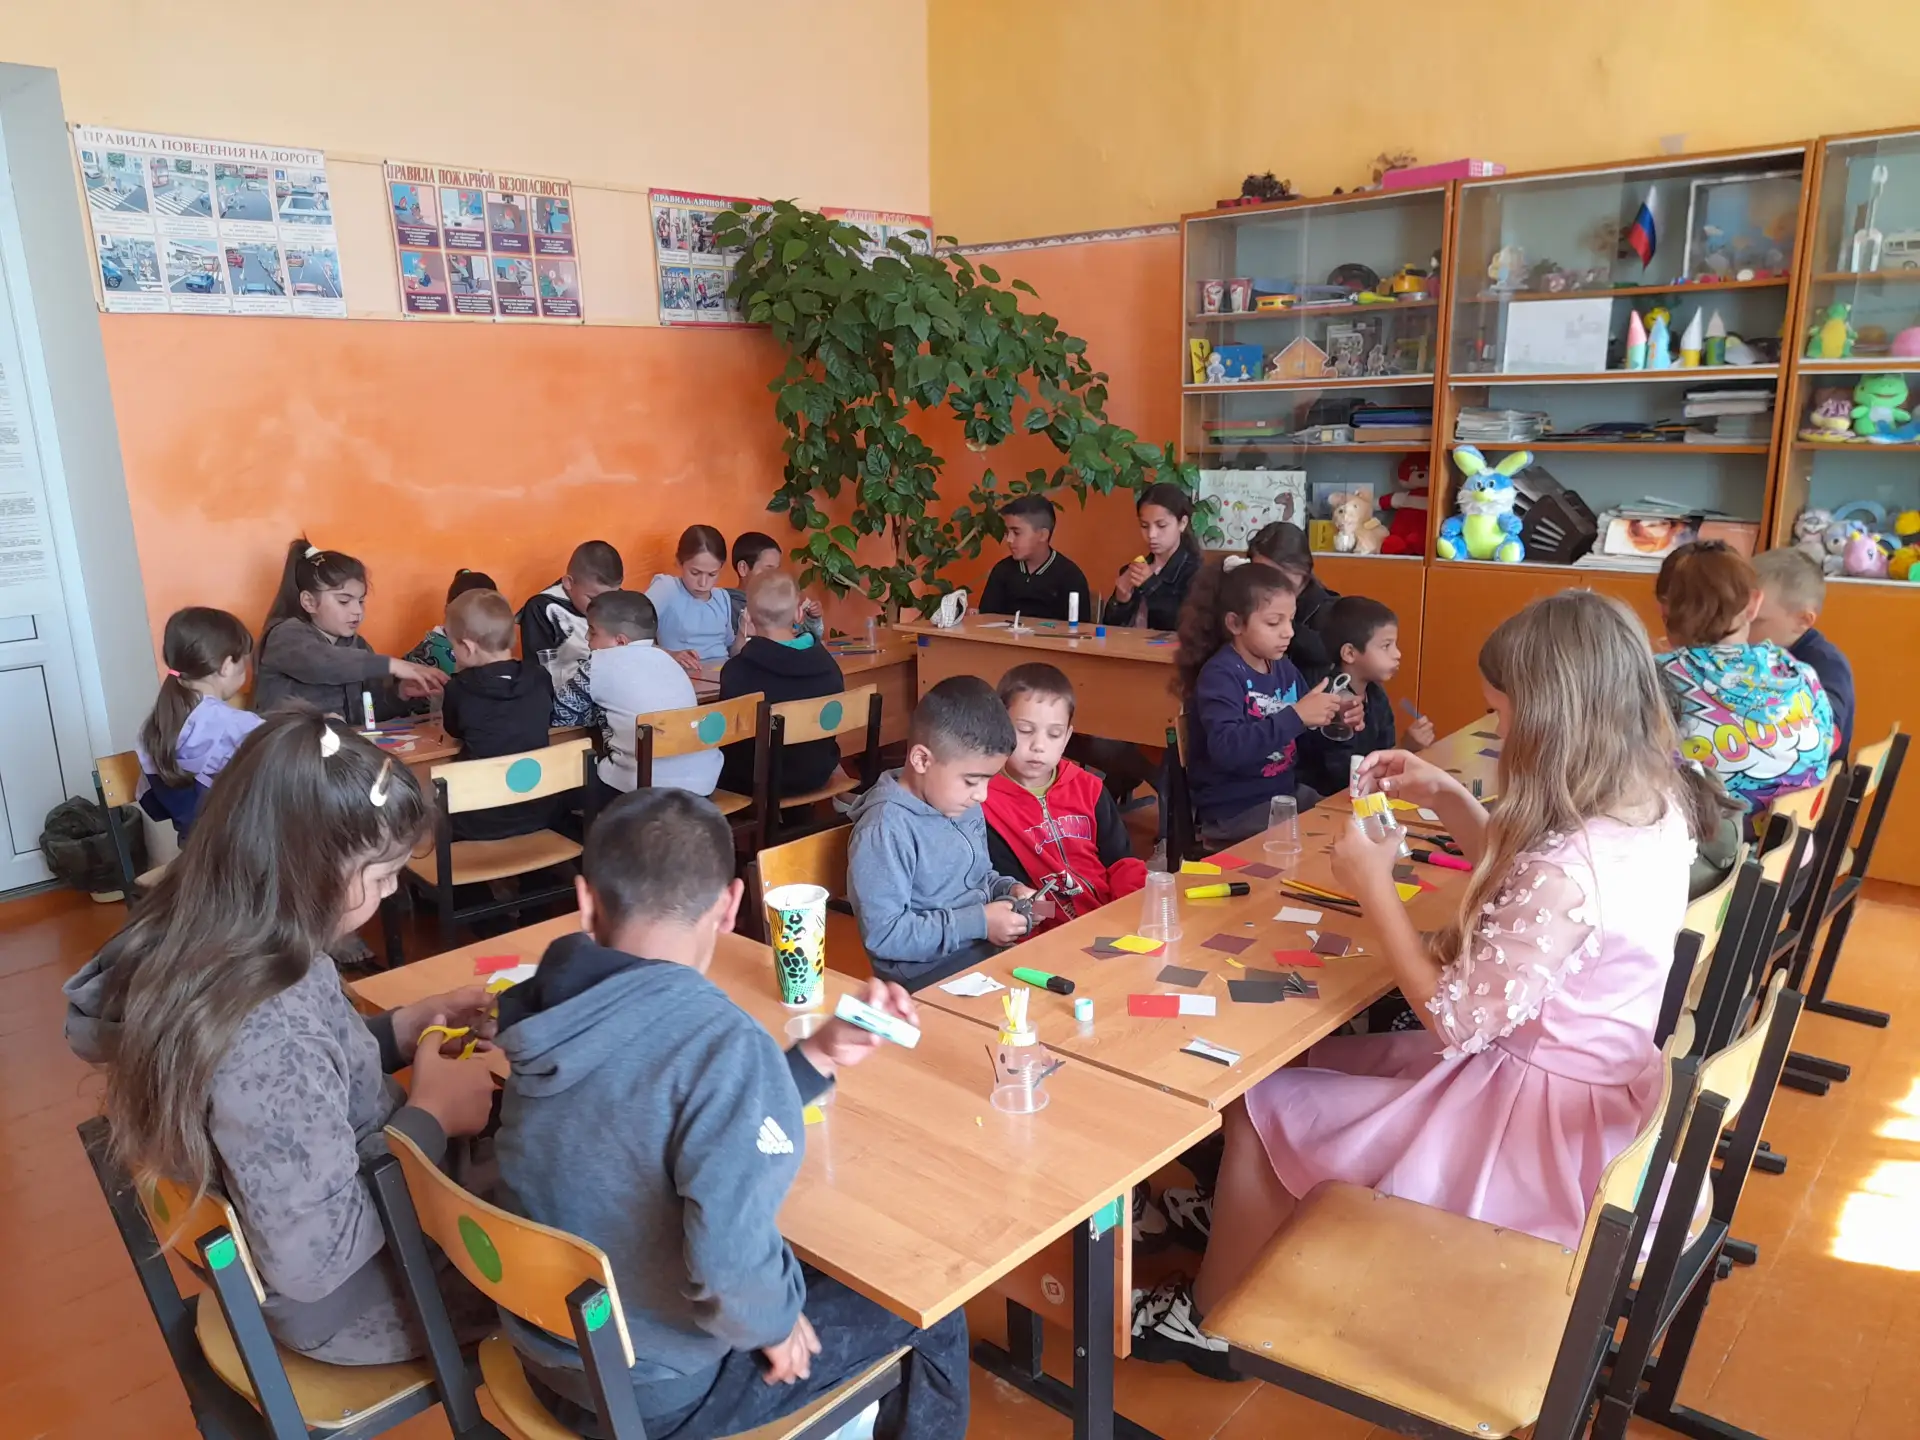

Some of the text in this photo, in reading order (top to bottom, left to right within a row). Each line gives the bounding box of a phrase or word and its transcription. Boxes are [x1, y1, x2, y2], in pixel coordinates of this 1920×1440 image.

[82, 129, 319, 166] ПРАВИЛА ПОВЕДЕНИЯ НА ДОРОГЕ
[386, 163, 570, 197] ПРАВИЛА ПОЖАРНОЙ БЕЗОПАСНОСТИ
[653, 193, 691, 205] ПРАВИЛА
[693, 198, 725, 208] ЛИЧНОЙ
